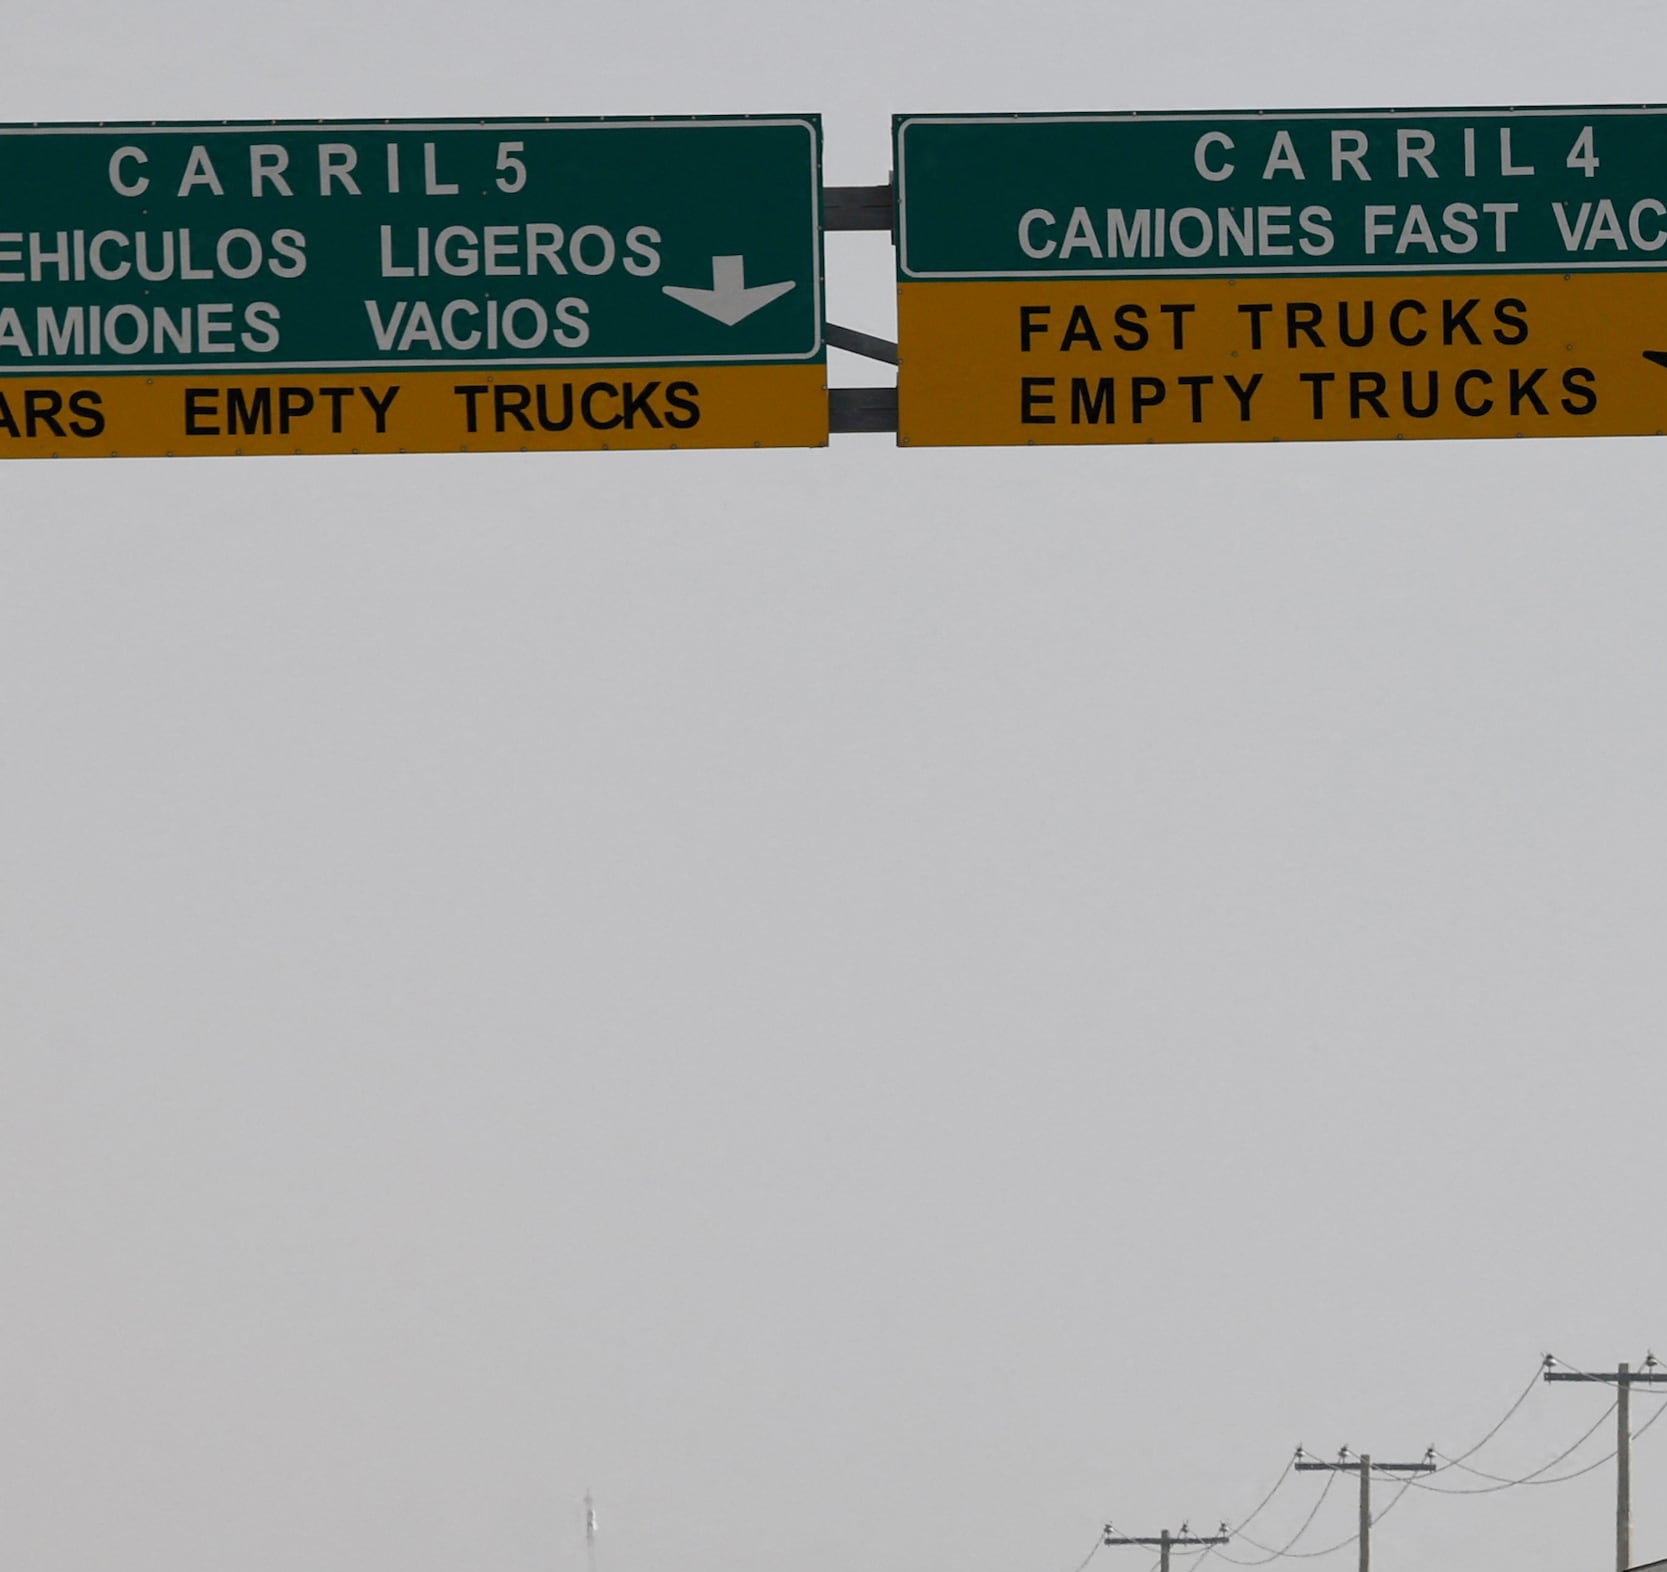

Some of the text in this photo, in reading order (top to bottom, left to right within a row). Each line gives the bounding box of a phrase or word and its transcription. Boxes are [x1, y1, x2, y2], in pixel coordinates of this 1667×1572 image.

[110, 142, 526, 196] CARRIL 5
[1195, 127, 1599, 181] CARRIL 4
[381, 224, 660, 276] LIGEROS
[1019, 206, 1334, 258] CAMIONES
[1366, 203, 1518, 253] FAST
[365, 298, 588, 350] VACIOS
[1020, 298, 1528, 352] FAST TRUCKS
[185, 386, 400, 435] EMPTY
[454, 381, 700, 432] TRUCKS
[1021, 368, 1597, 424] EMPTY TRUCKS
